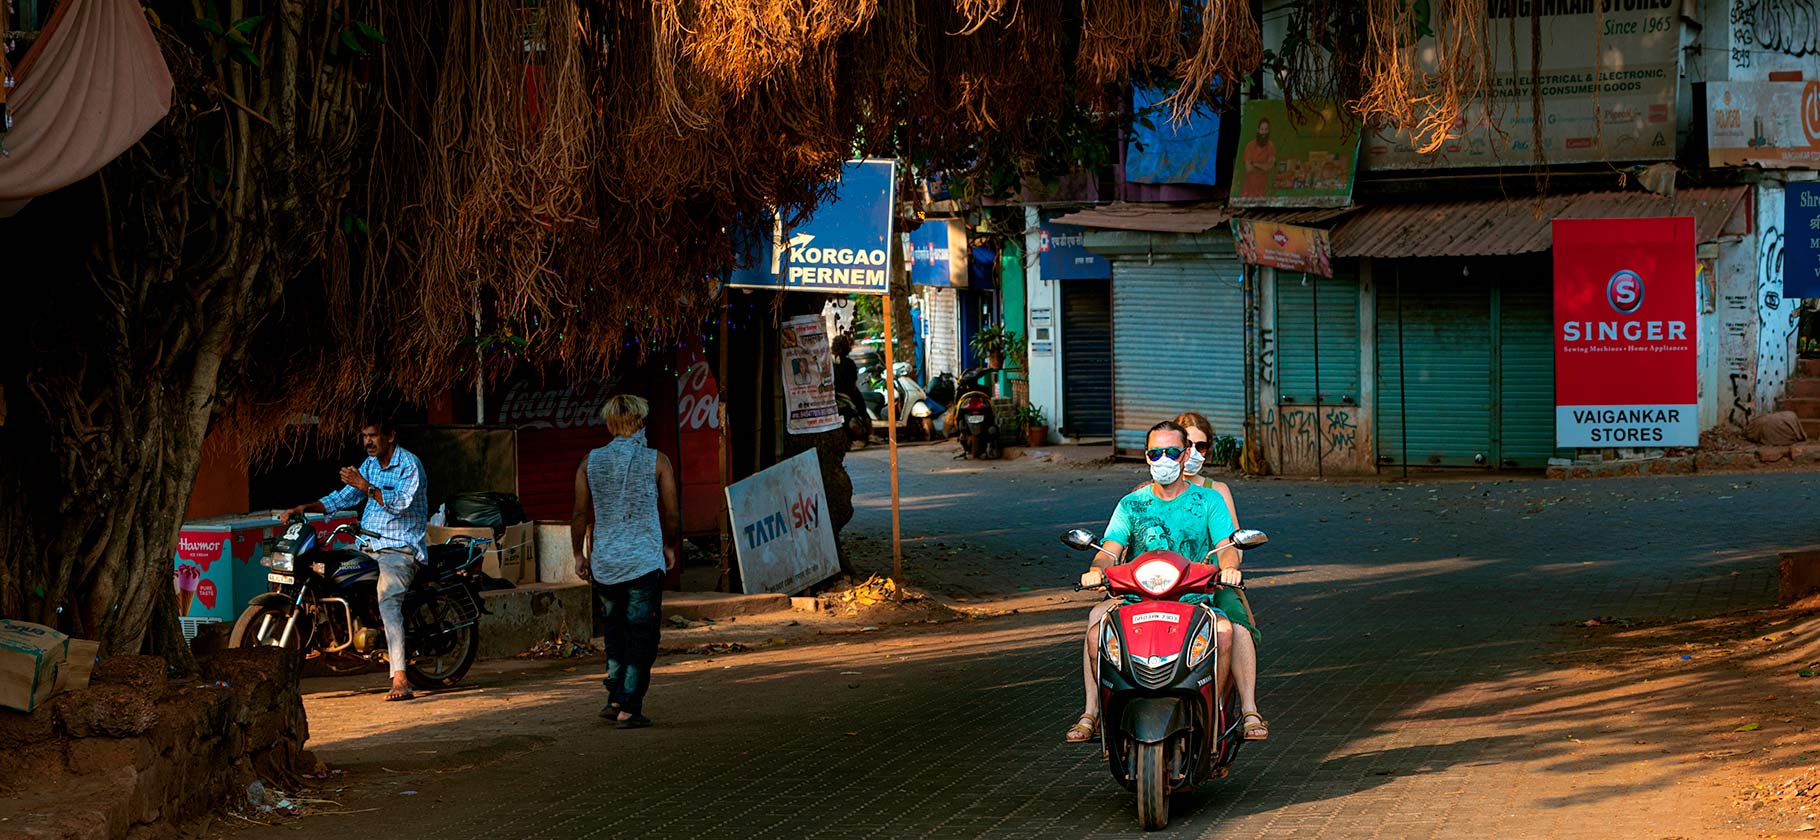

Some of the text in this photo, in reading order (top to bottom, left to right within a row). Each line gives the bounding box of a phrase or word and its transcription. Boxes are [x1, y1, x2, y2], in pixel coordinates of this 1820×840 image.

[1603, 16, 1673, 36] Since 1965
[1520, 74, 1583, 87] ELCTRICAL
[1586, 74, 1594, 83] &
[1604, 81, 1641, 92] GOODS
[790, 248, 886, 266] KORGAO
[789, 266, 885, 287] PERNEM
[1616, 281, 1636, 304] S
[1563, 320, 1687, 341] SINGER
[1564, 345, 1588, 354] Sewing
[1650, 345, 1688, 353] Appliances
[1574, 409, 1680, 424] VAIGANKAR
[1591, 427, 1663, 442] STORES
[744, 491, 819, 550] TATA sky
[179, 537, 221, 551] Havmor
